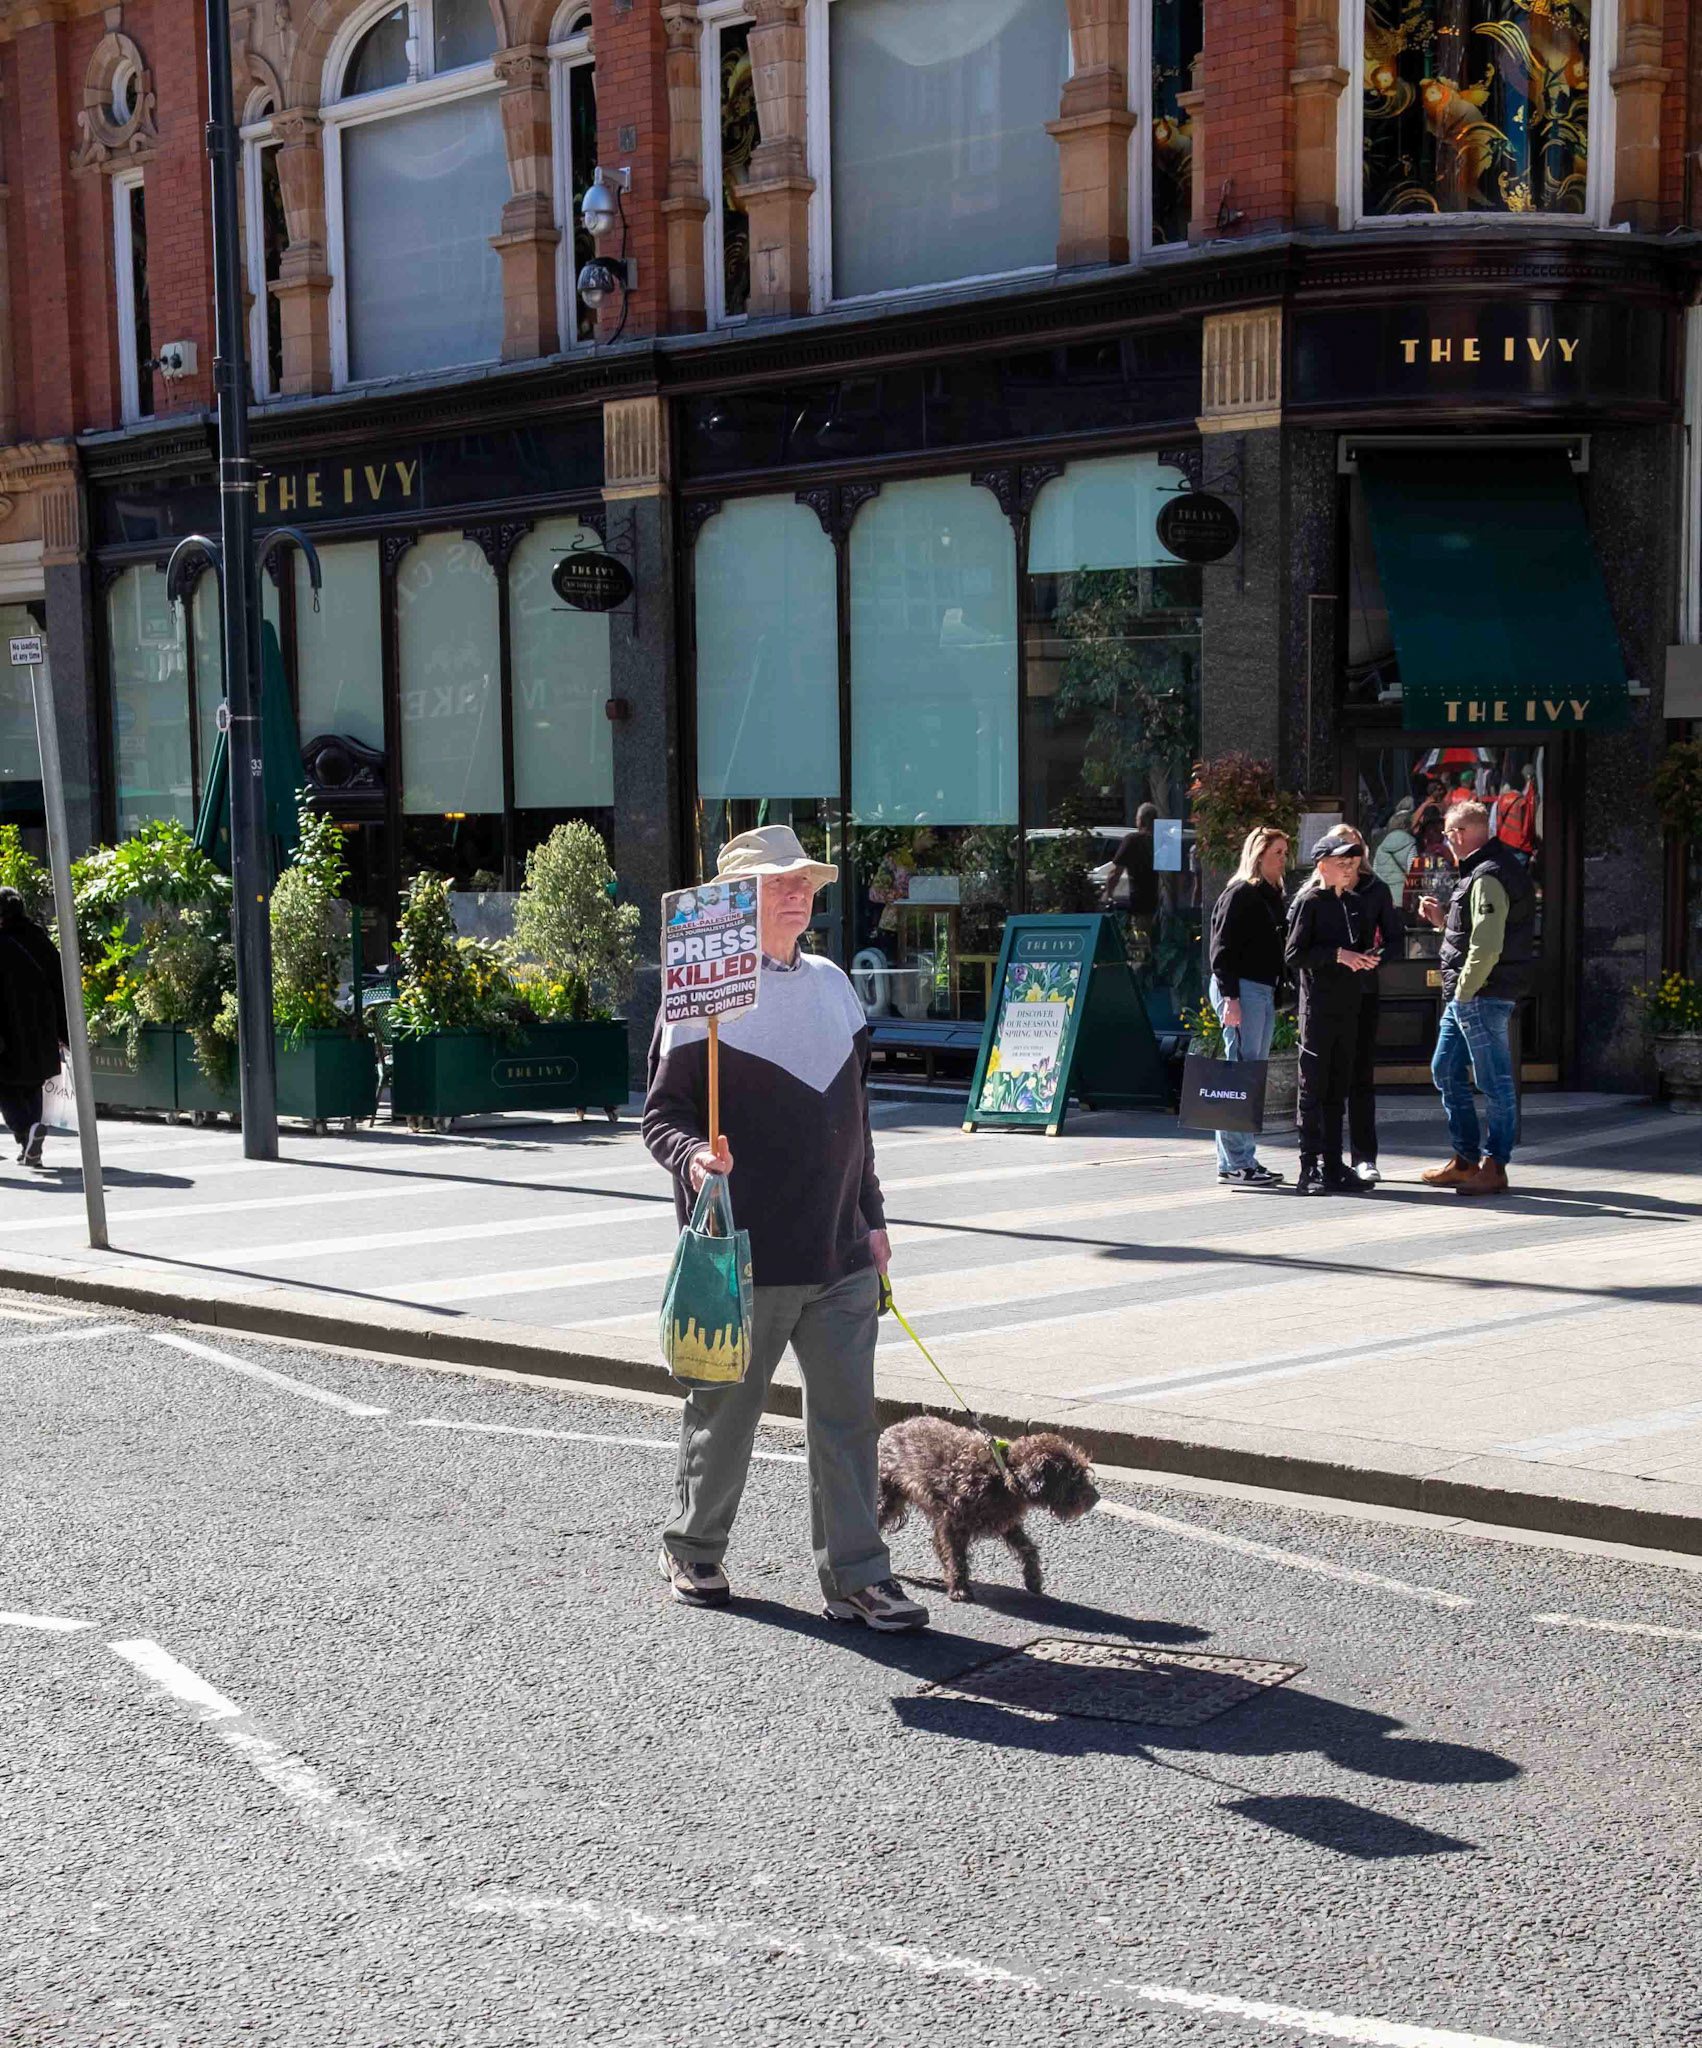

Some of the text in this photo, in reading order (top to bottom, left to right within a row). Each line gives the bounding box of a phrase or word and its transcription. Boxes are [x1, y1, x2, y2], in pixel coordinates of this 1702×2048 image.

[1400, 337, 1579, 363] THE IVY
[256, 460, 417, 513] THE IVY
[571, 565, 591, 576] THE
[21, 641, 39, 650] loading
[19, 653, 28, 661] any
[29, 651, 40, 659] time
[1444, 700, 1590, 722] THE IVY
[250, 758, 263, 770] 33
[667, 918, 746, 940] GAZA JOURNALISTS KILLED
[668, 912, 742, 934] ISRAEL-PALESTINE
[667, 925, 757, 966] PRESS
[1026, 940, 1076, 951] THE IVY
[667, 952, 757, 991] KILLED
[666, 980, 756, 1008] FOR UNCOVERING
[667, 993, 753, 1020] WAR CRIMES
[1016, 1009, 1054, 1018] DISCOVER
[1006, 1019, 1059, 1028] OUR SEASONAL
[1004, 1029, 1059, 1039] SPRING MENUS
[507, 1065, 563, 1078] THE IVY
[1199, 1088, 1247, 1100] FLANNELS
